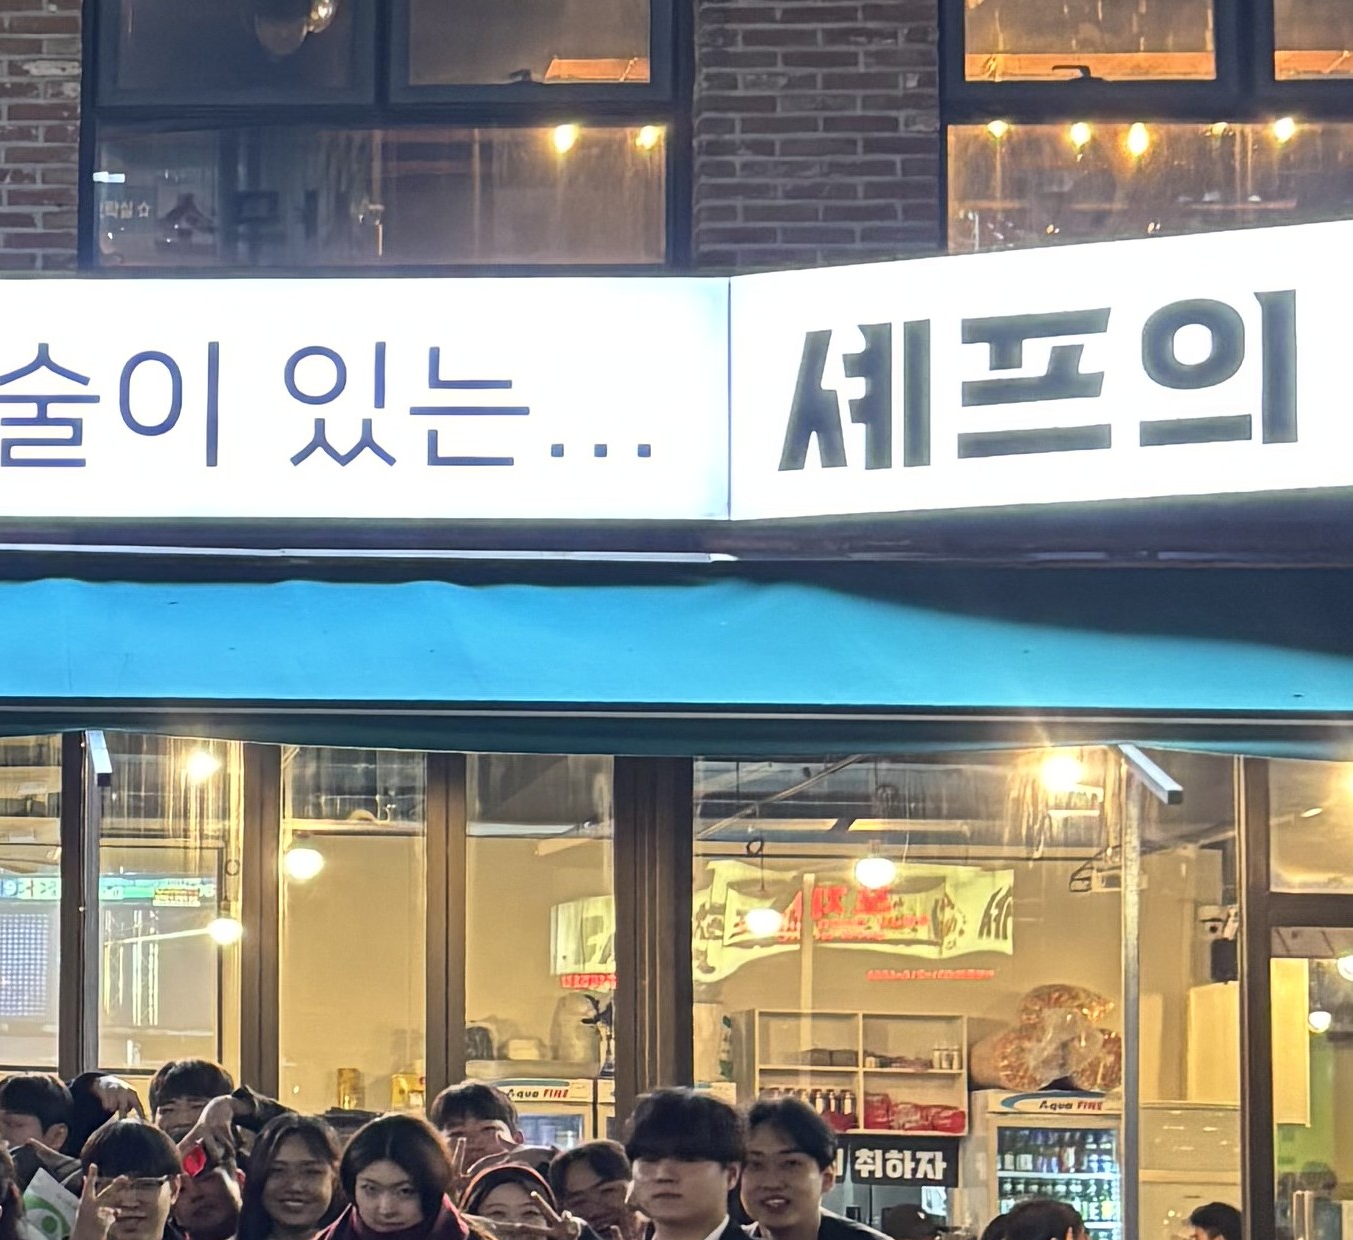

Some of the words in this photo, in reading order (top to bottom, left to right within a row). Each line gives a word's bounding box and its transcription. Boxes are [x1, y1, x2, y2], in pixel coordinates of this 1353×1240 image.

[284, 341, 652, 467] 있는...
[778, 289, 1298, 471] 셰프의
[854, 1148, 947, 1181] 취하자
